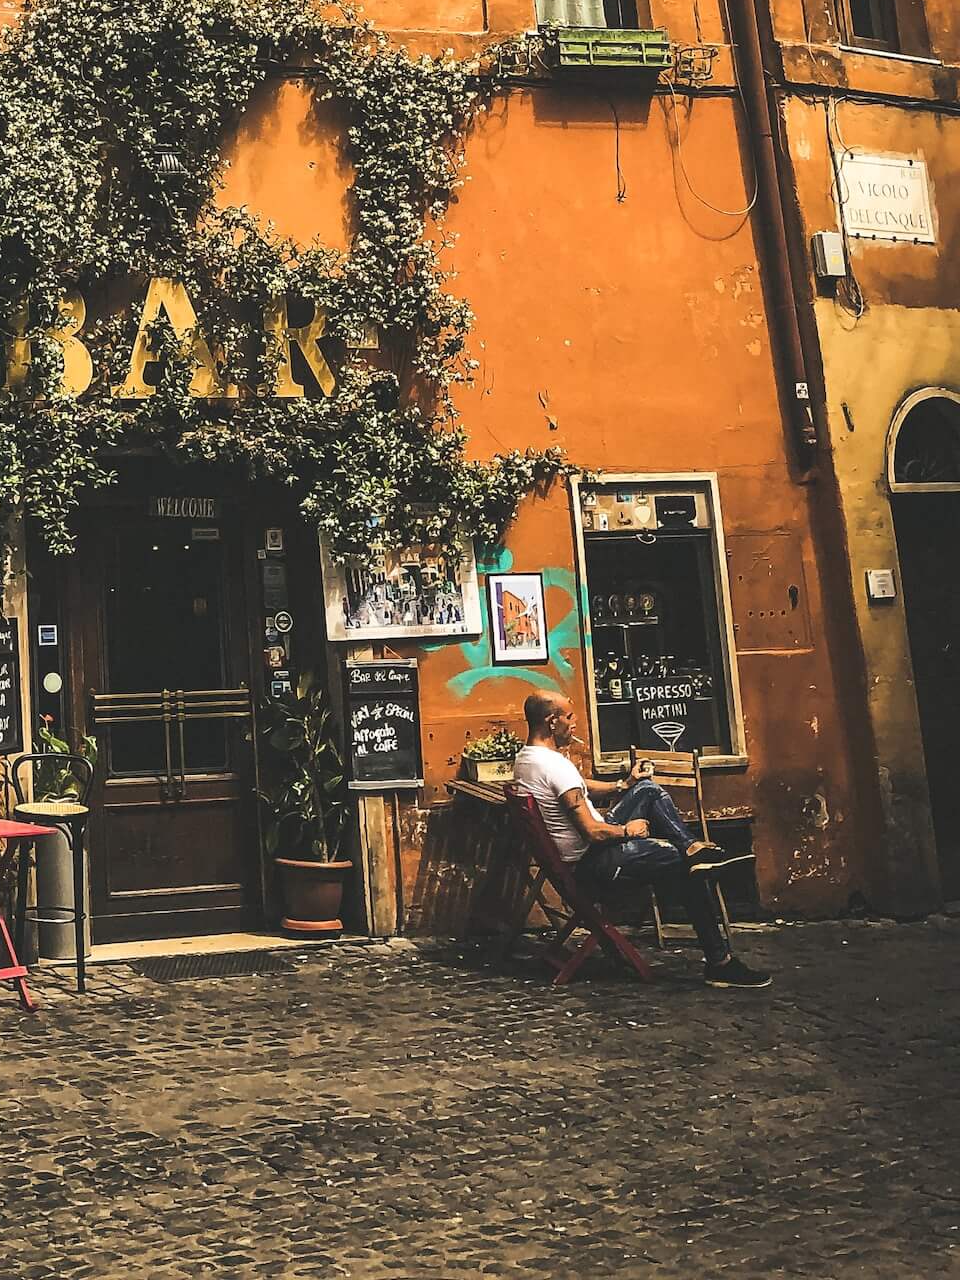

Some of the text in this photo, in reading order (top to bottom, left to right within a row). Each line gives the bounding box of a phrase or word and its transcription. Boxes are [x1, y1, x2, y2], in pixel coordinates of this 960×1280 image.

[849, 207, 926, 231] DEL CINQUE
[0, 276, 337, 399] BAR
[158, 497, 215, 518] WELCOME
[636, 683, 692, 703] ESPRESSO
[642, 702, 688, 721] MARTINI
